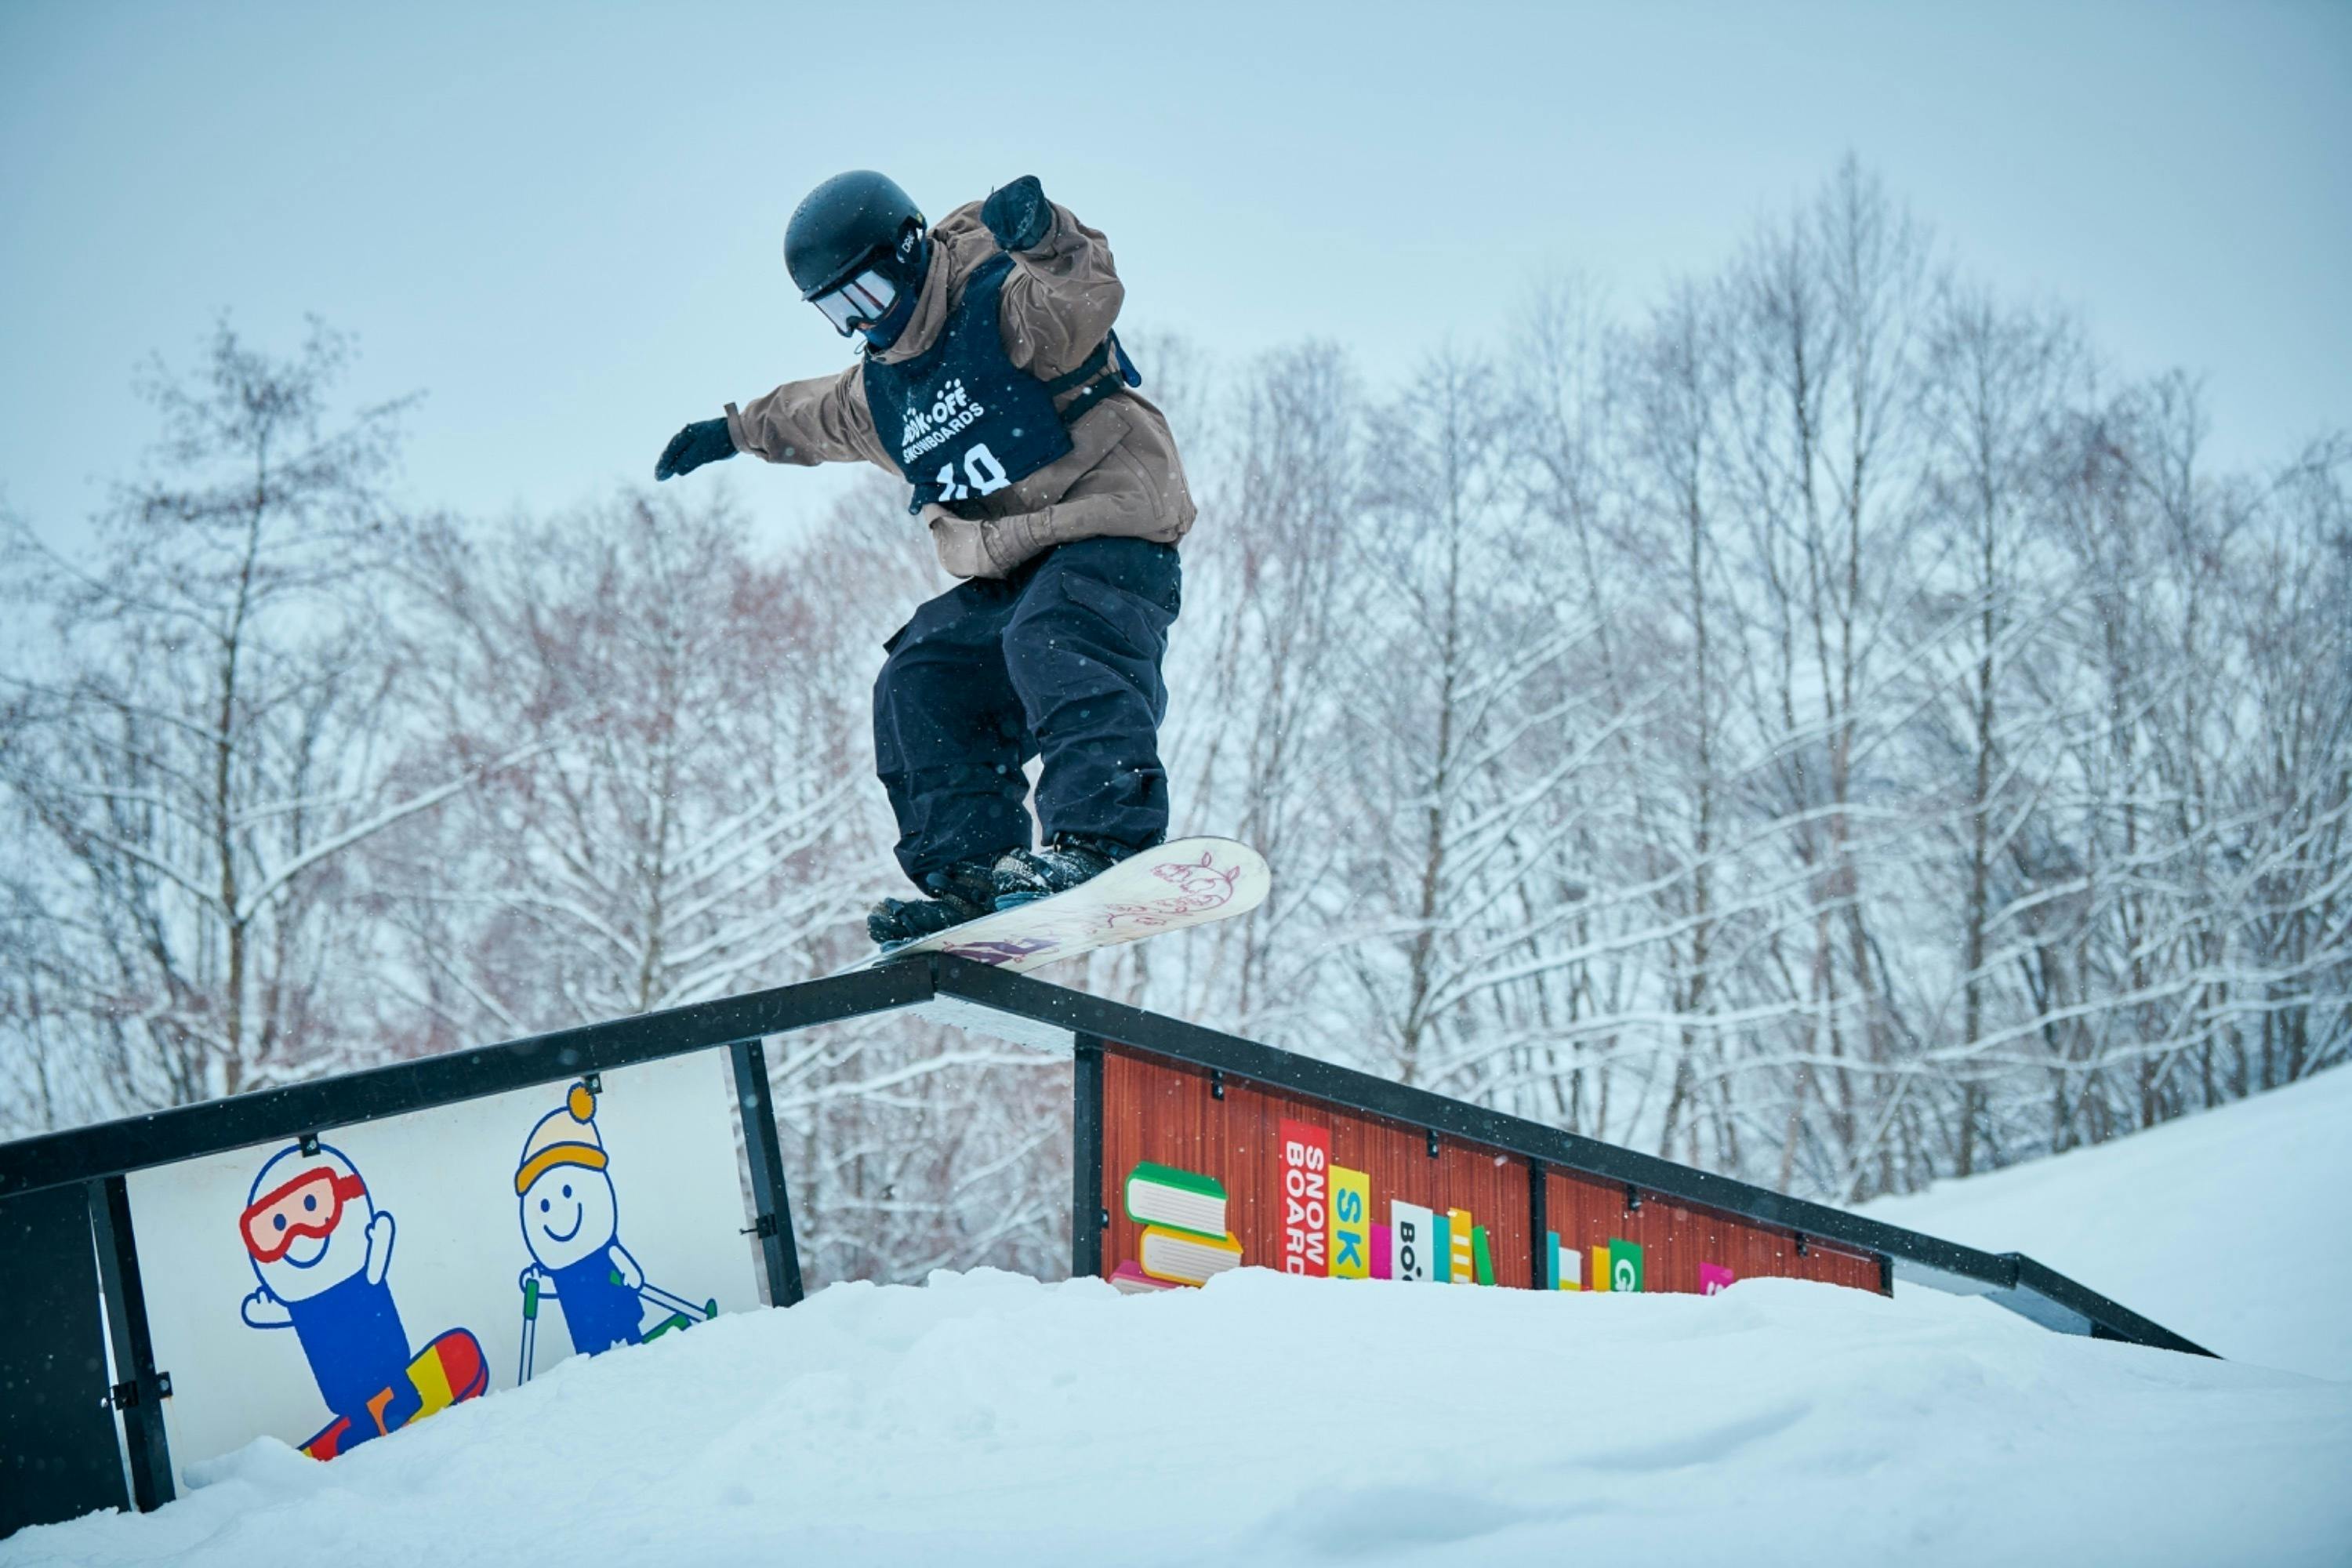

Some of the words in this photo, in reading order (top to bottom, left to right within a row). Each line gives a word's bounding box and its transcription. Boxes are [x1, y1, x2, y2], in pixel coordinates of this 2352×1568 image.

[902, 402, 985, 464] SNOWBOARDS
[1305, 1145, 1325, 1267] SNOW
[1337, 1188, 1362, 1279] SK
